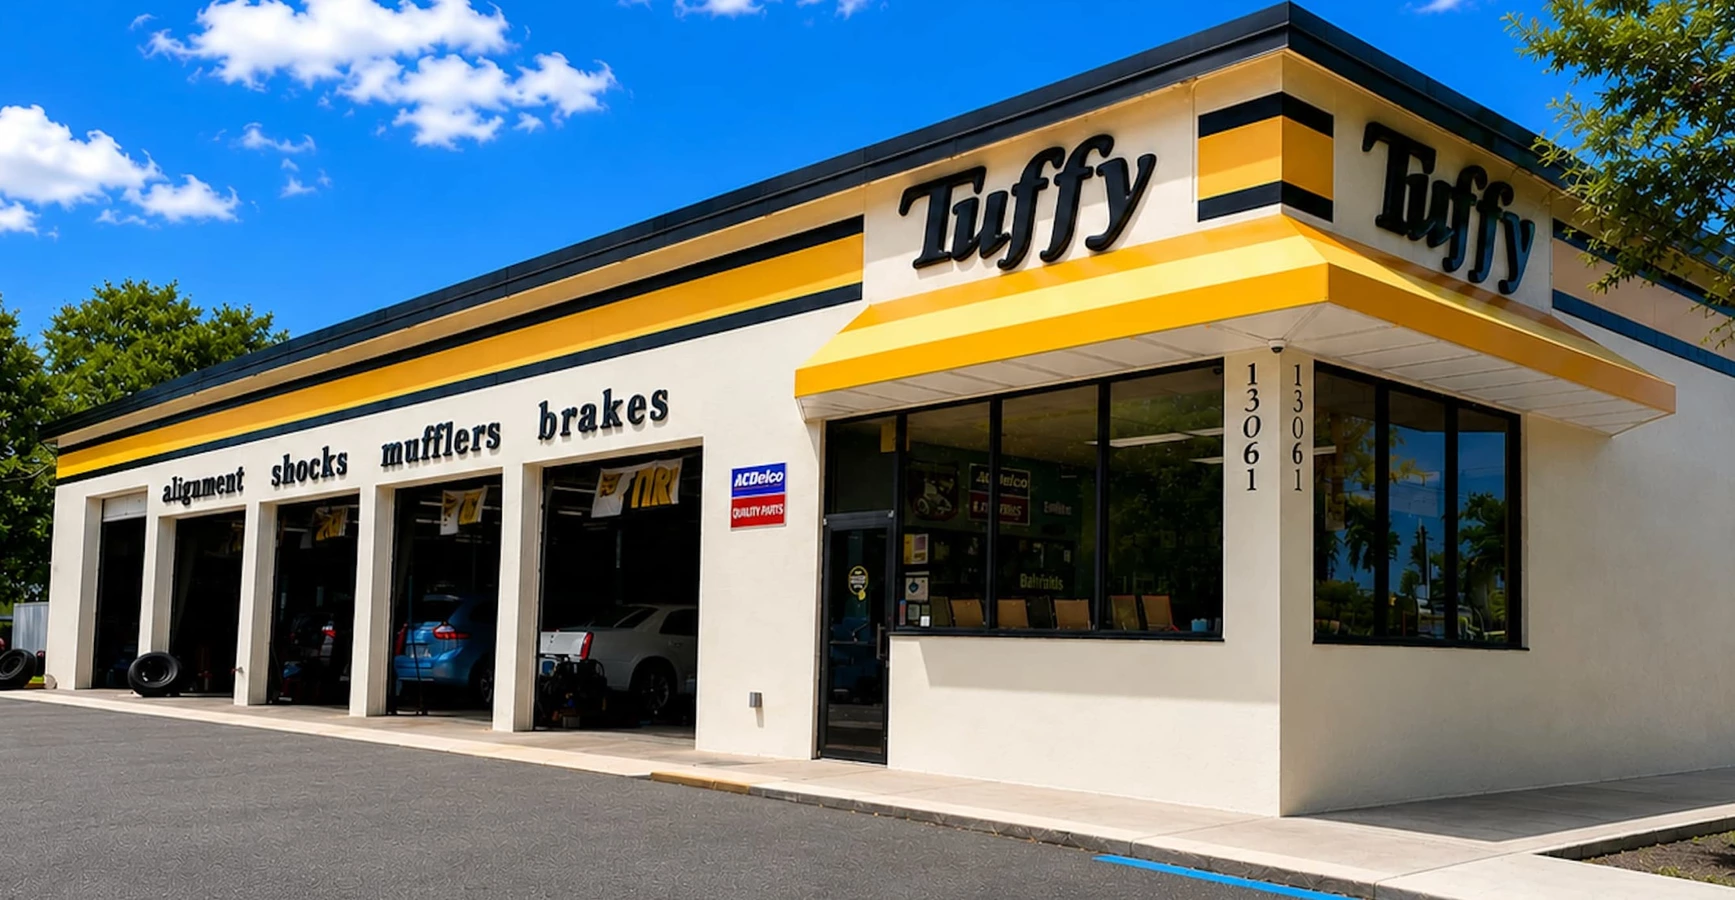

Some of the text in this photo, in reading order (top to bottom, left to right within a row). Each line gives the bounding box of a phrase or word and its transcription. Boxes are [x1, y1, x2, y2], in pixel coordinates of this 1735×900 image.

[899, 134, 1157, 270] Tuffy
[1362, 121, 1535, 295] Tuffy
[162, 388, 669, 505] alignment shocks mufflers brakes
[734, 469, 784, 487] ACDelco
[1243, 363, 1261, 491] 13061
[1292, 364, 1304, 492] 13061
[732, 503, 784, 519] QUALITY PARTS
